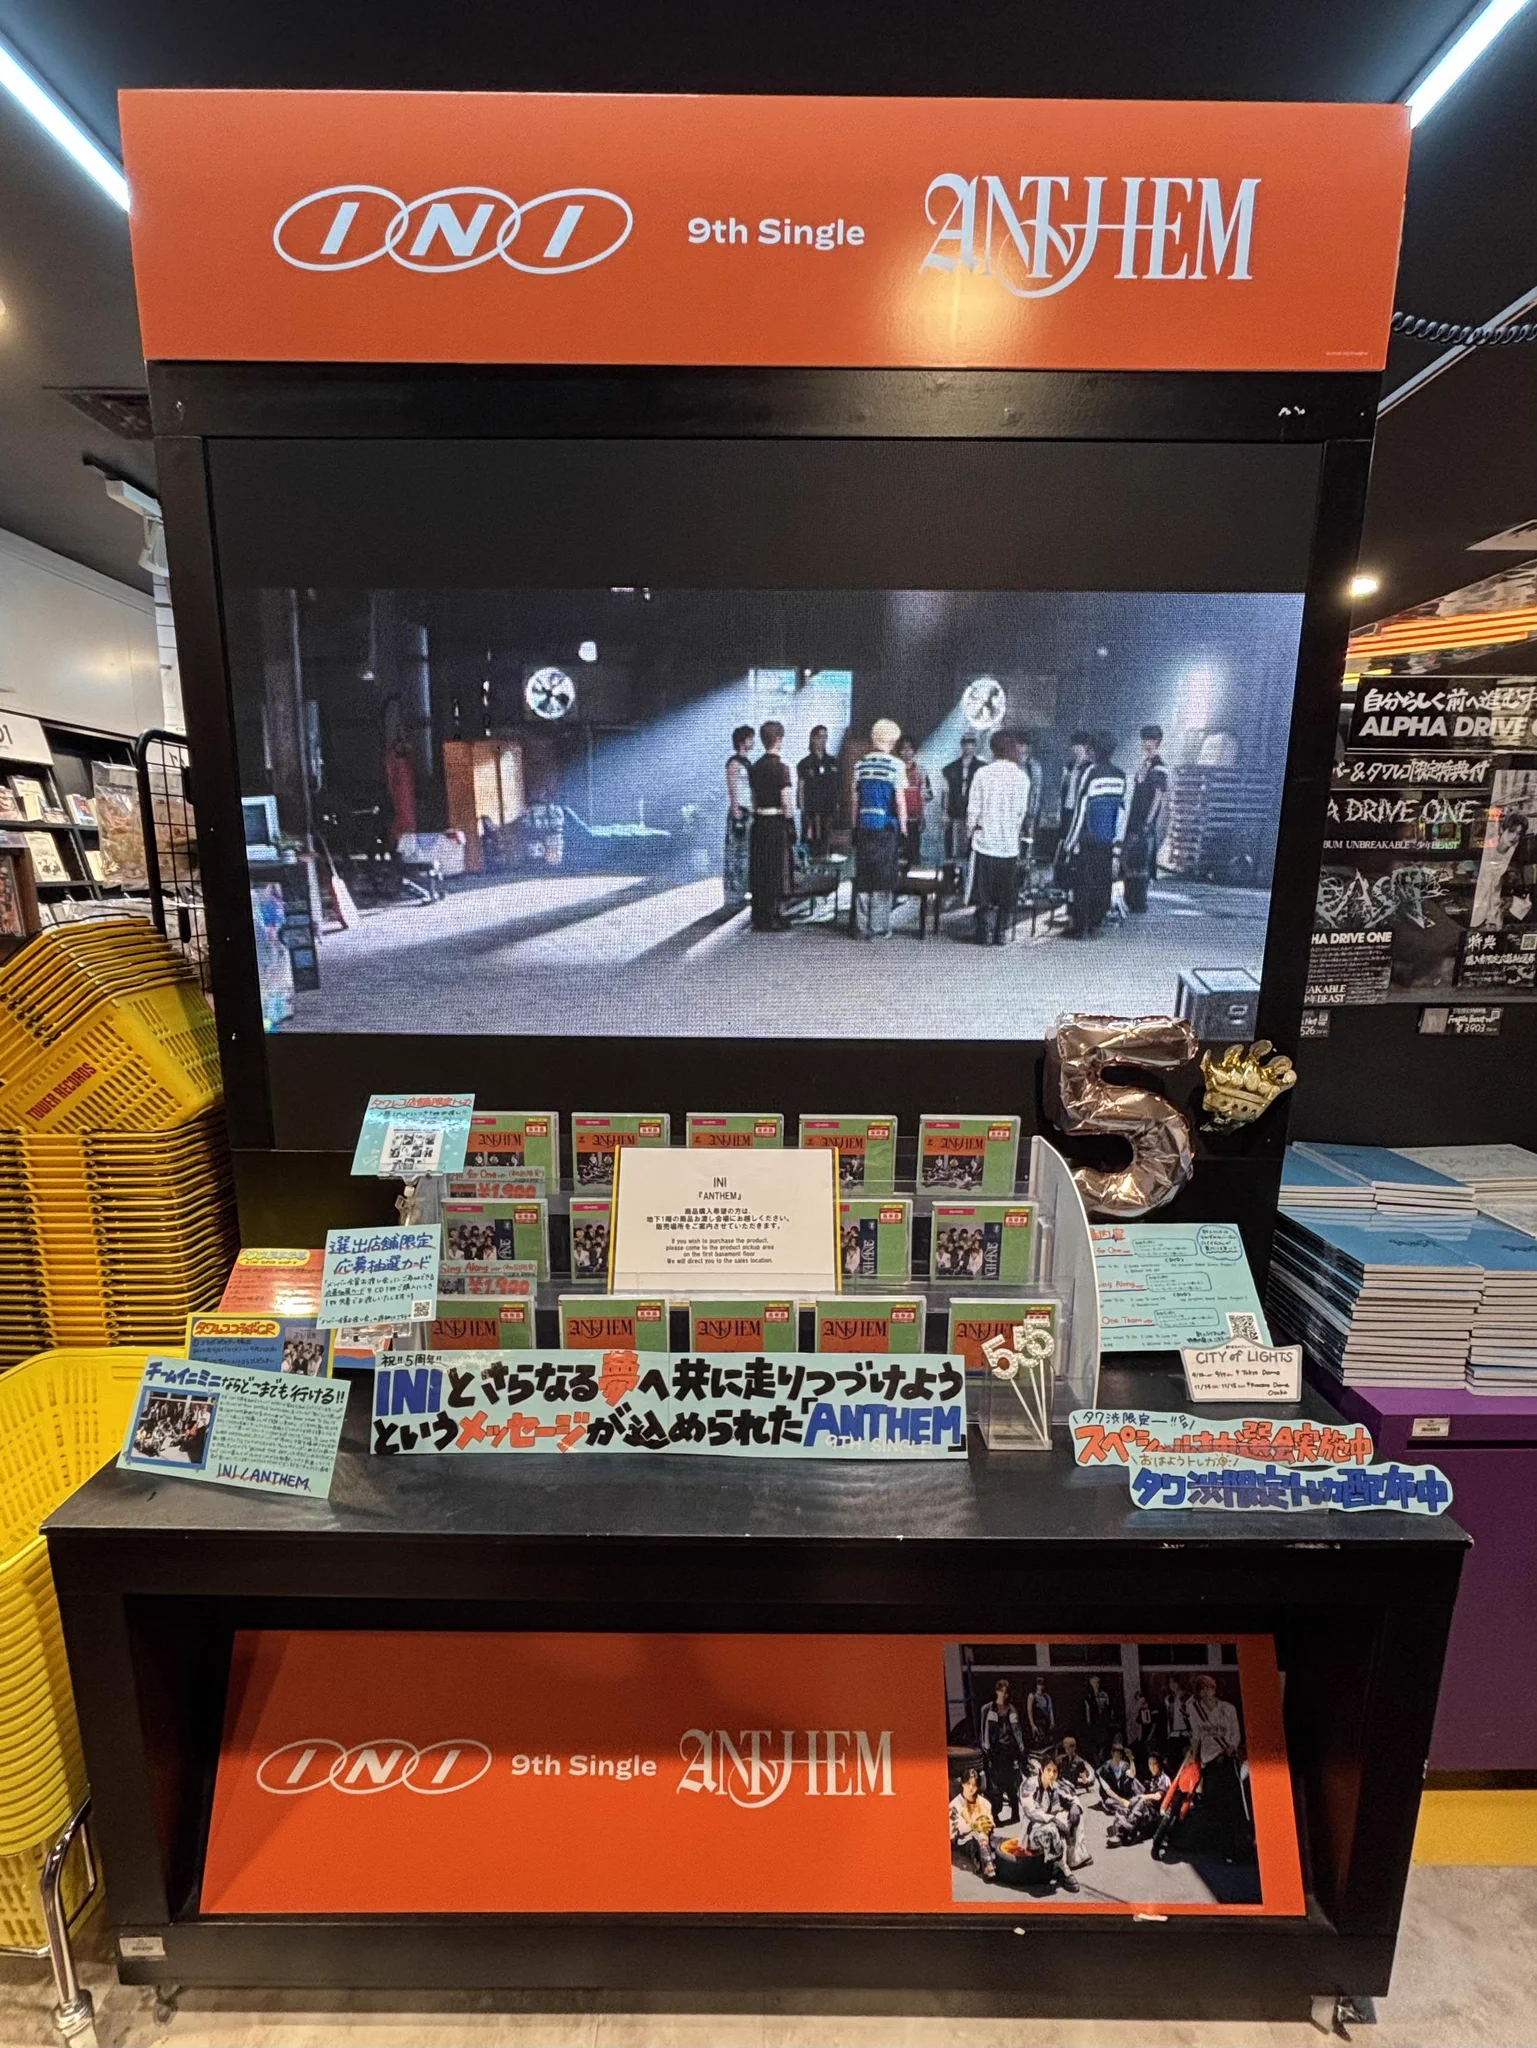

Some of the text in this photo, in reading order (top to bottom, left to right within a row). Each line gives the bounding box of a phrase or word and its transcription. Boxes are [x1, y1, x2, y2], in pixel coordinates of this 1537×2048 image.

[320, 172, 1262, 298] INI 9th Single ANTHEM
[1359, 716, 1528, 737] ALPHA DRIVE
[1345, 799, 1420, 824] DRIVE
[1422, 799, 1480, 824] ONE
[1330, 932, 1365, 944] DRIVE
[1366, 931, 1393, 943] ONE
[26, 1062, 97, 1121] TOWER RECORDS
[713, 1177, 727, 1187] INI
[328, 1232, 435, 1255] 選出店舗限定
[334, 1255, 432, 1275] 応募抽選カード
[569, 1319, 633, 1338] ANTHEM
[698, 1320, 761, 1339] ANTHEM
[823, 1320, 887, 1340] ANTHEM
[1196, 1350, 1294, 1364] CITY of LIGHTS
[217, 1462, 238, 1480] INI
[250, 1470, 309, 1490] ANTHEM
[287, 1728, 897, 1809] INI 9th Single ANTHEM
